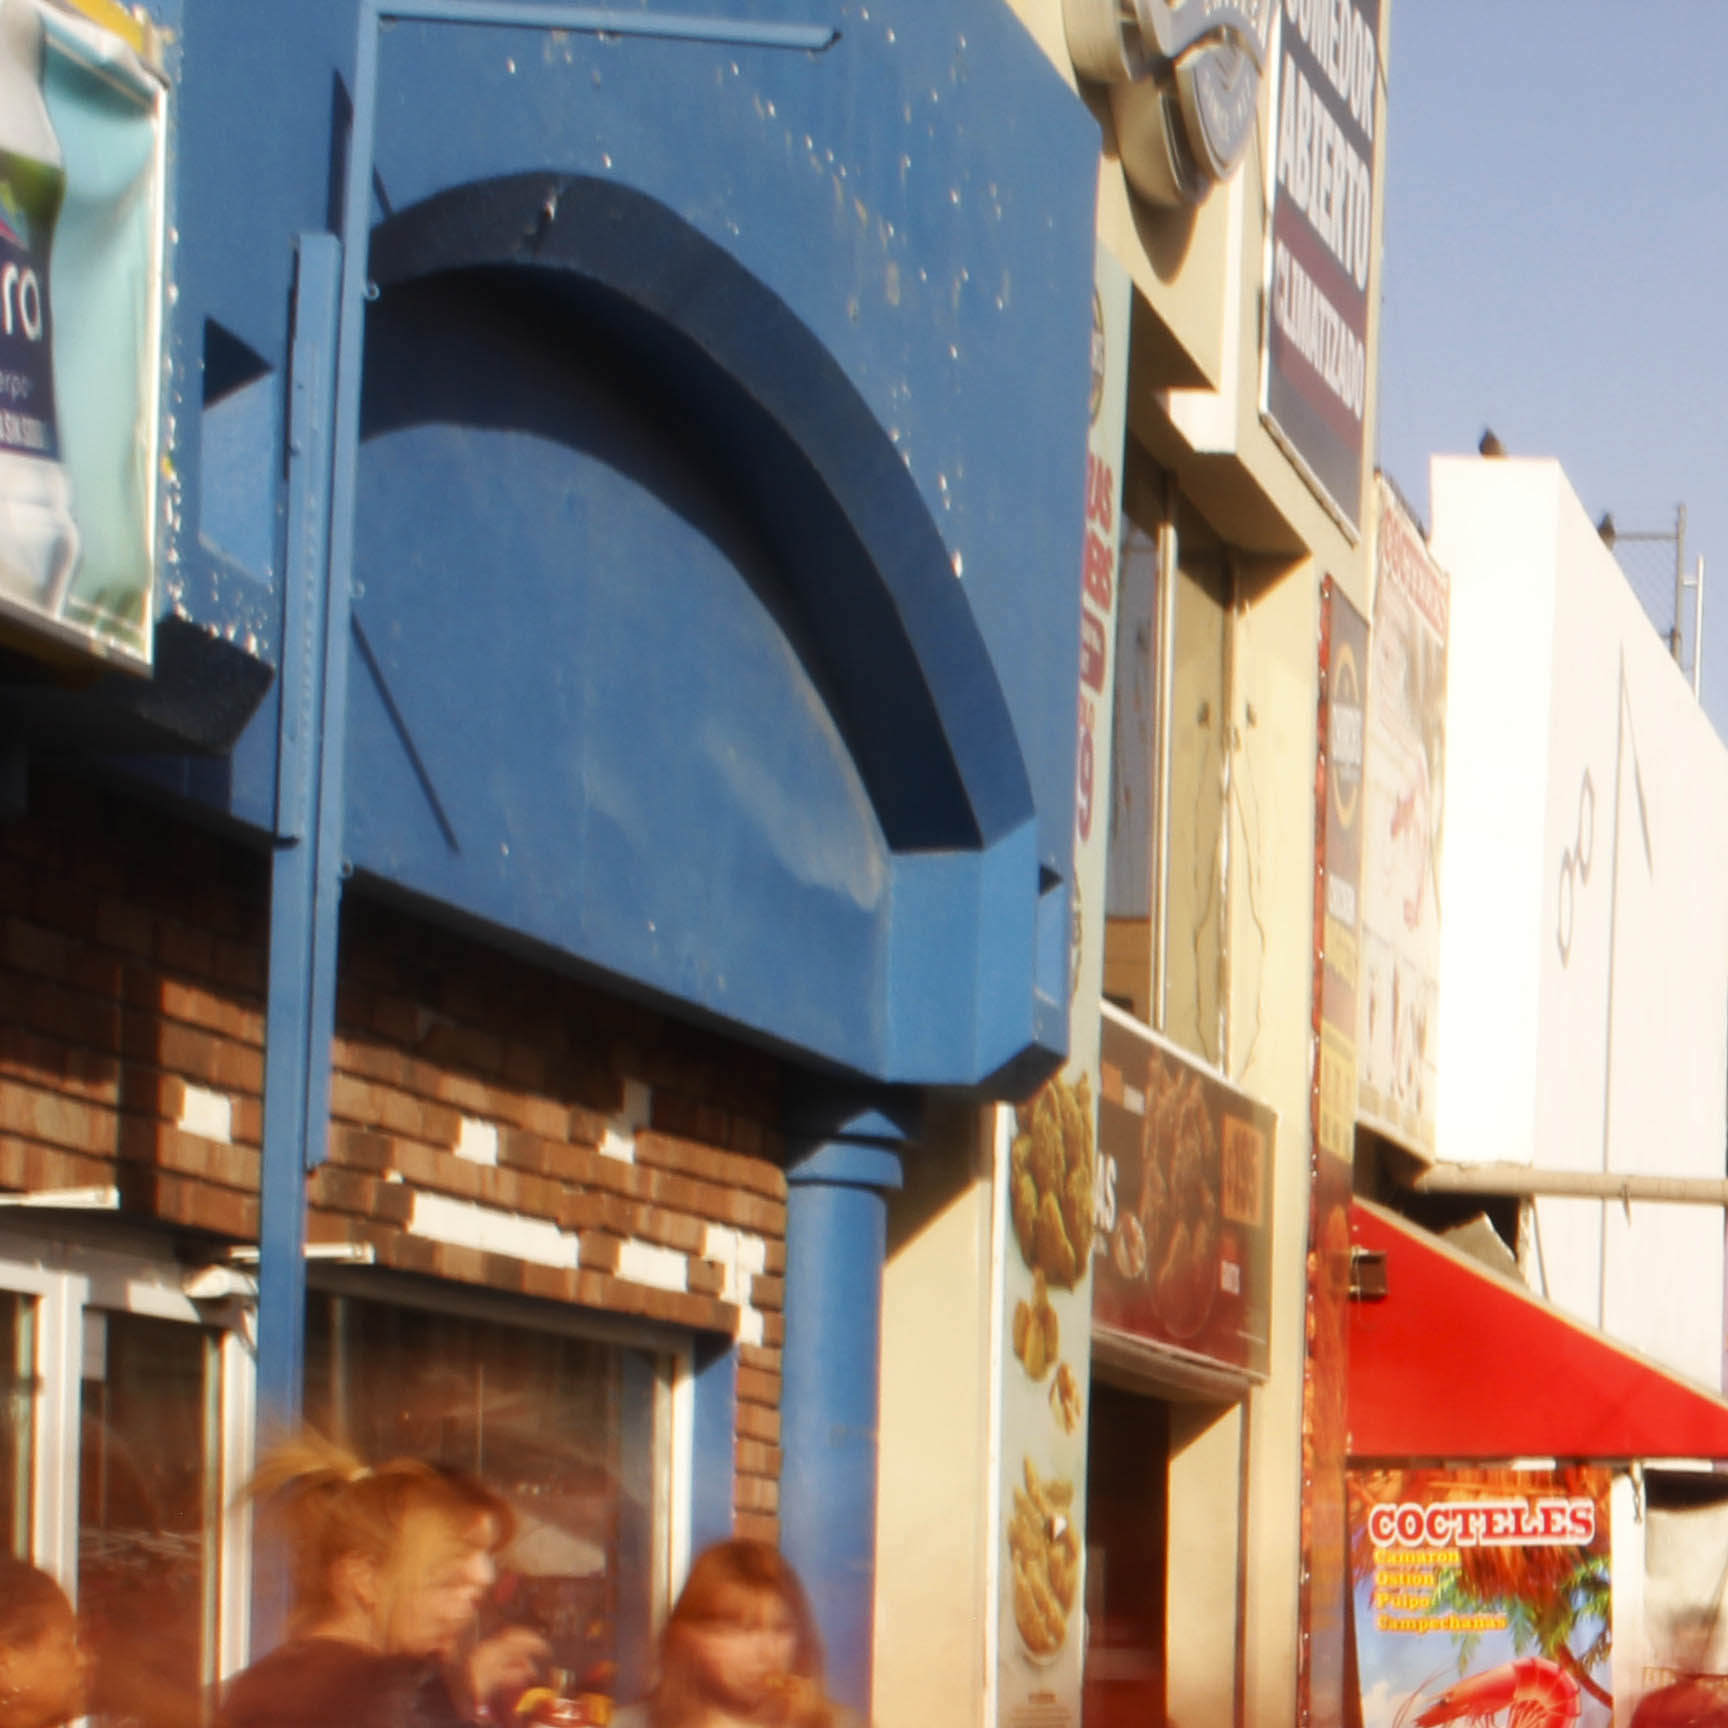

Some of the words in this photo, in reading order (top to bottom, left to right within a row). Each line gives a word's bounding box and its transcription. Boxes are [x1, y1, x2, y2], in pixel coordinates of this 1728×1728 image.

[1285, 0, 1376, 144] MEDOR
[1278, 51, 1371, 292] ABIERTO
[1273, 237, 1365, 420] CLIMATIZADO
[1370, 1502, 1595, 1544] COCTELES
[1376, 1593, 1430, 1610] Pulpo
[1377, 1615, 1508, 1633] Campechanas
